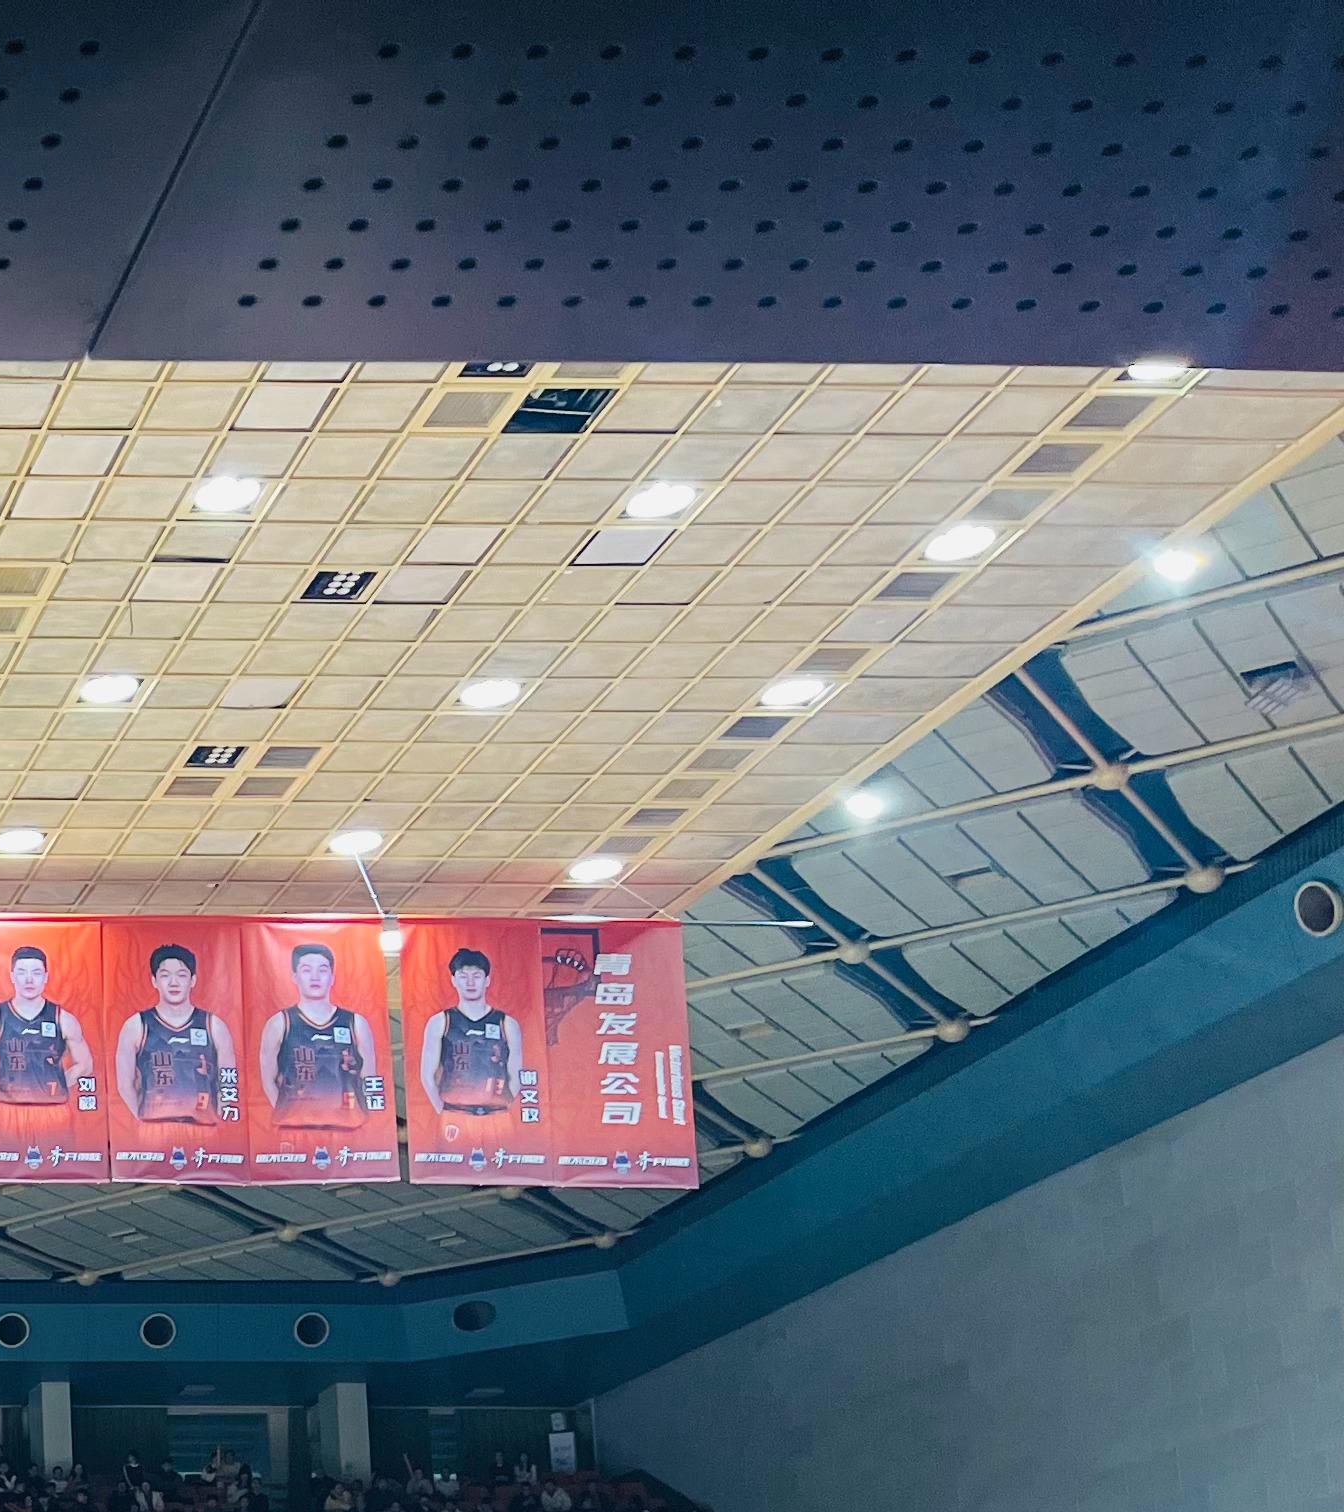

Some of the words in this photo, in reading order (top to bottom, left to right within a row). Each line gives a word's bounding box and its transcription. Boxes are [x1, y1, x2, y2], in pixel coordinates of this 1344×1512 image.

[6, 1038, 27, 1072] 山东
[452, 1039, 471, 1073] 山东
[594, 953, 642, 1125] 青岛发展公司
[151, 1050, 175, 1088] 山东
[293, 1045, 317, 1081] 山东
[78, 1076, 97, 1110] 刘毅
[365, 1076, 386, 1110] 王征
